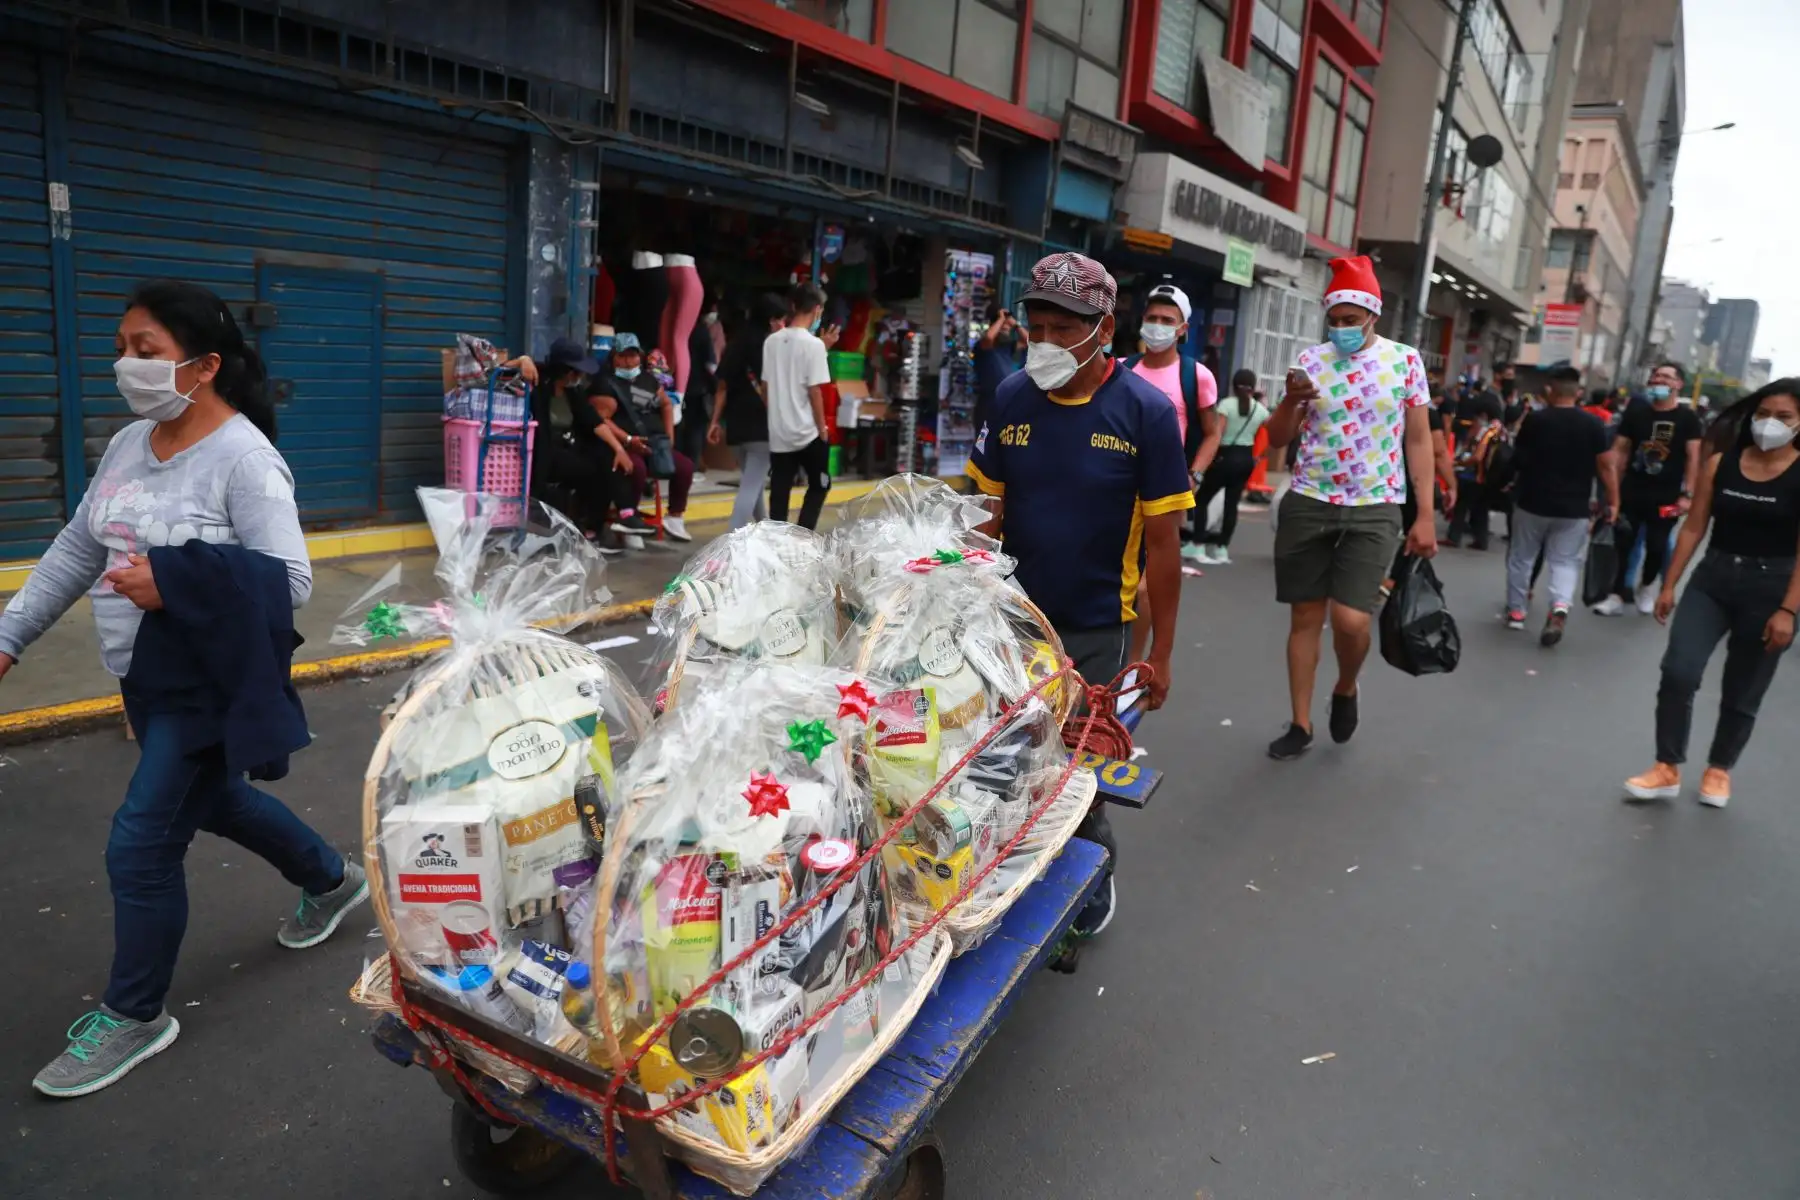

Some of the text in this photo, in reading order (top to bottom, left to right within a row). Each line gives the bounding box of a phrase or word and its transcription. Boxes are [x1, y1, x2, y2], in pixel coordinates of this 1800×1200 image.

[1016, 424, 1031, 446] 62
[1091, 433, 1130, 454] GUSTAVO
[415, 858, 458, 868] QUAKER
[403, 884, 478, 893] AVENA TRADICIONAL
[761, 1001, 802, 1051] GLORIA
